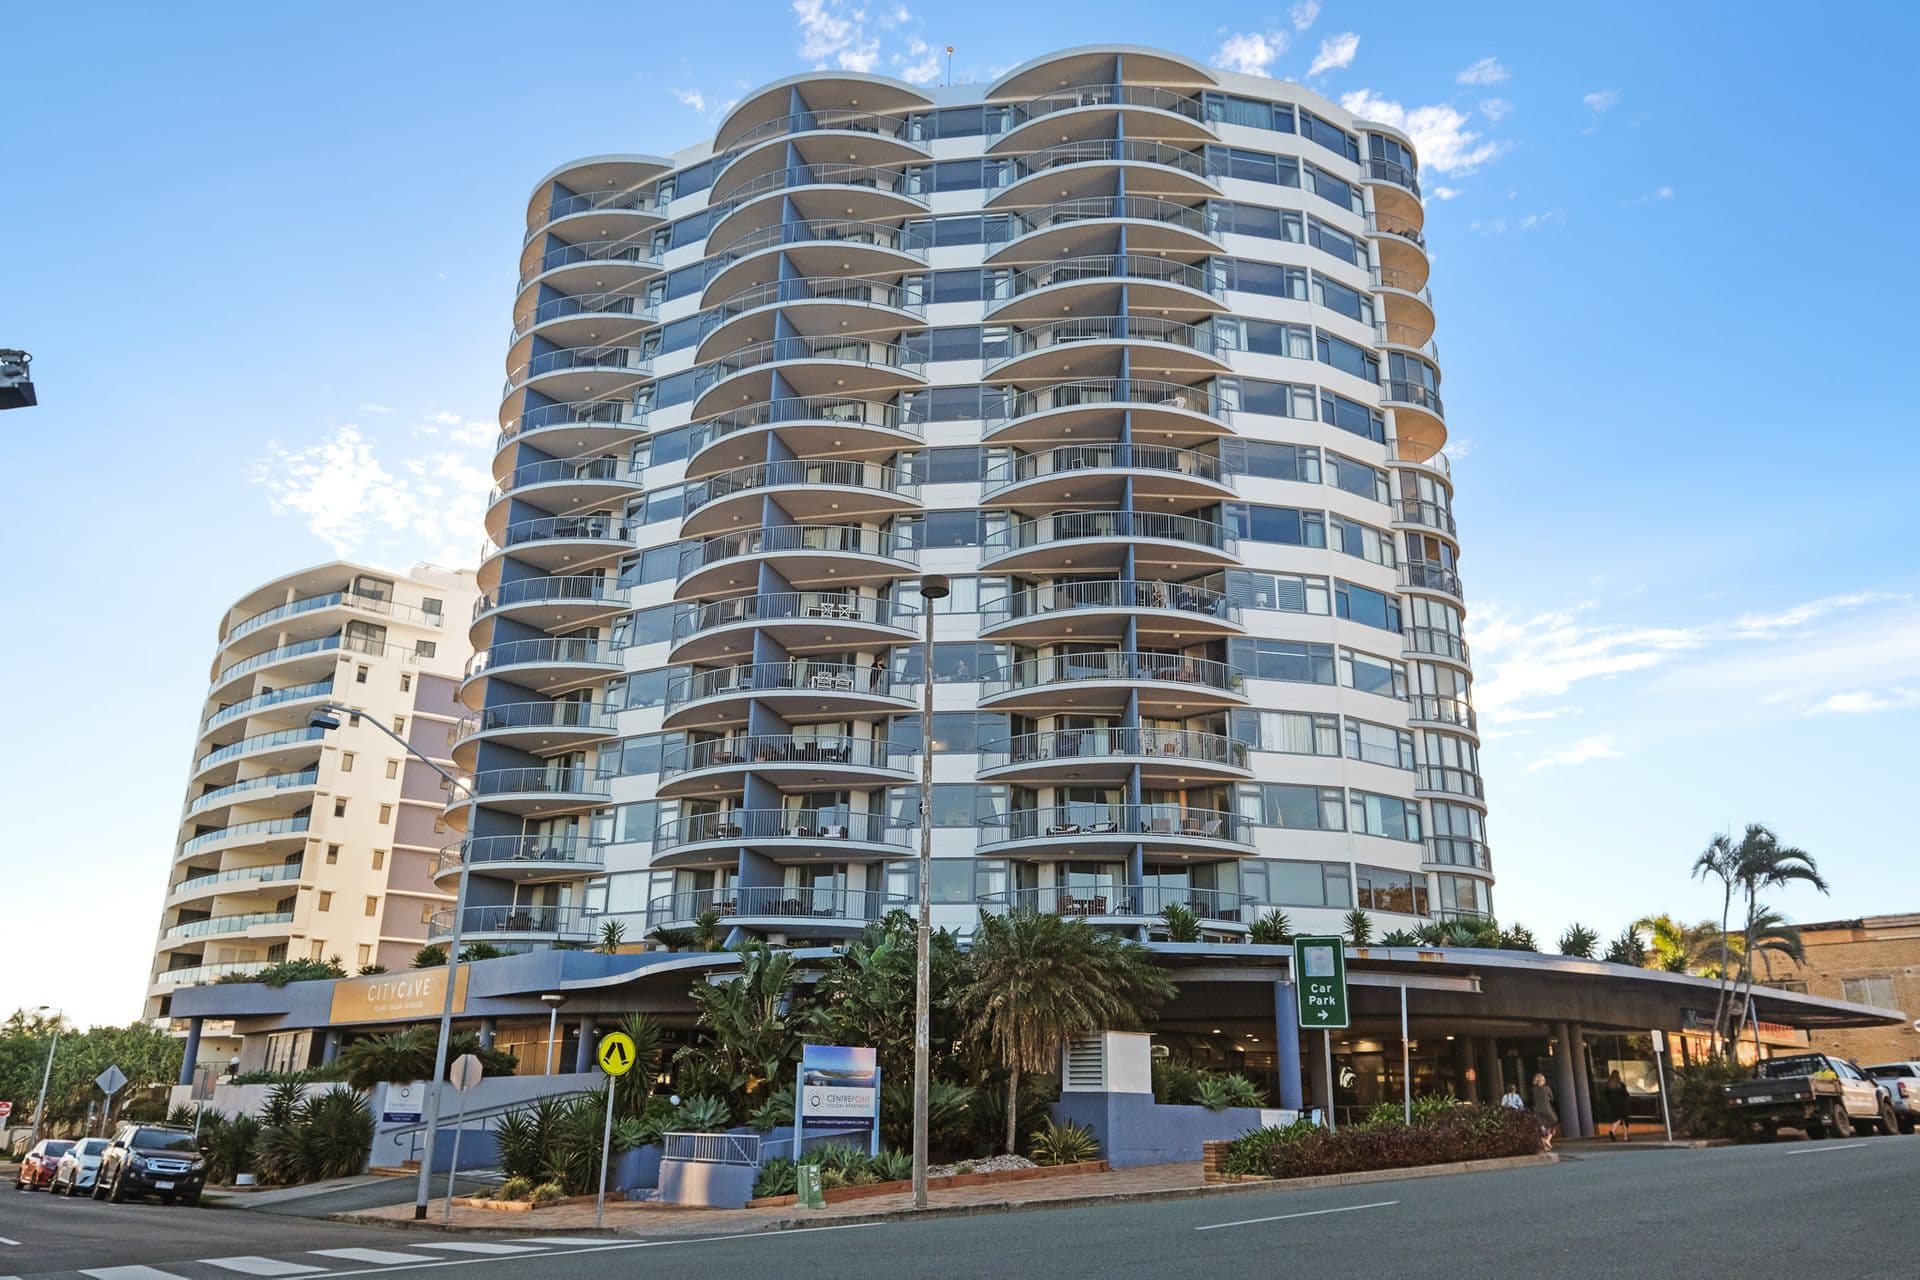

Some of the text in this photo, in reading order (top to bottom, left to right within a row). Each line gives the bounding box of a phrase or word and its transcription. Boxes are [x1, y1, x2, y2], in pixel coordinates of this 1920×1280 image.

[1311, 984, 1332, 993] Car
[1309, 996, 1336, 1006] Park
[827, 1095, 870, 1105] CENTREPOINT
